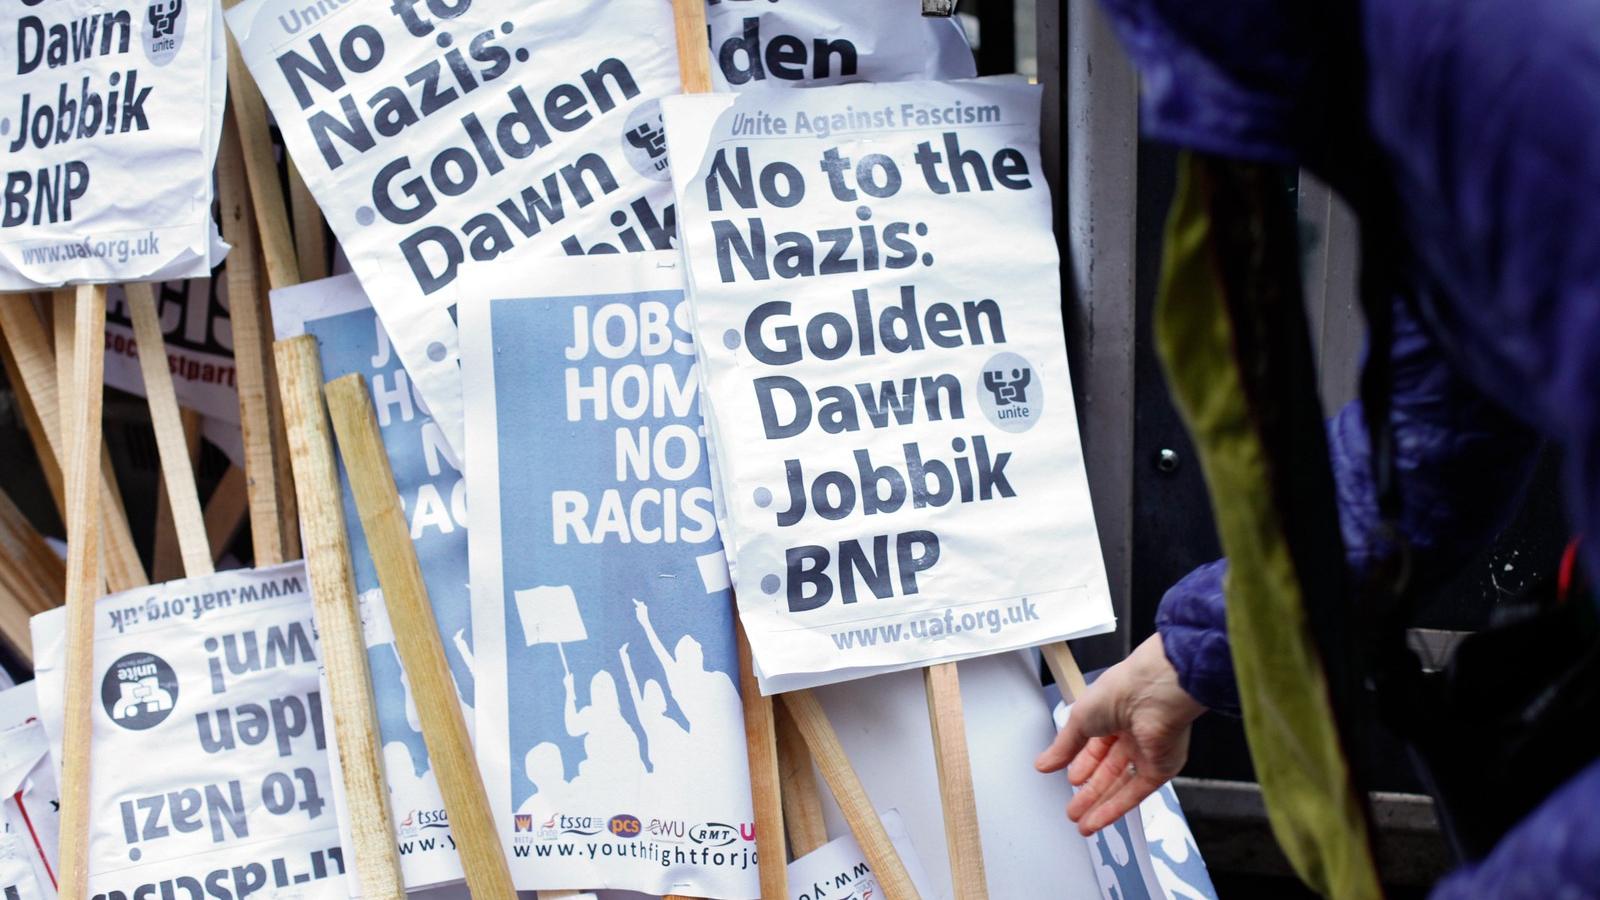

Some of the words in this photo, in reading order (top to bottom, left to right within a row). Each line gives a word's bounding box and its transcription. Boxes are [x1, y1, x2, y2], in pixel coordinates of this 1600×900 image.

[17, 8, 131, 76] Dawn
[276, 24, 385, 111] No
[10, 70, 154, 154] Jobbik
[308, 21, 530, 171] Nazis:
[731, 110, 788, 136] Unite
[794, 106, 896, 139] Against
[900, 100, 1001, 127] Fascism
[371, 57, 641, 225] Golden
[705, 146, 805, 211] No
[820, 147, 902, 202] to
[914, 132, 1032, 195] the
[1, 160, 90, 228] BNP
[399, 152, 619, 296] Dawn
[22, 231, 160, 265] www.uaf.org.uk
[711, 206, 934, 283] Nazis:
[565, 300, 695, 361] JOBS
[744, 285, 1007, 366] Golden
[753, 370, 965, 440] Dawn
[997, 405, 1030, 420] unite
[615, 424, 705, 482] NO
[776, 435, 1017, 527] Jobbik
[552, 487, 716, 546] RACIS
[109, 576, 303, 634] www.uaf.org.uk
[785, 530, 941, 613] BNP
[204, 617, 319, 694] wn!
[831, 597, 1040, 650] www.uaf.org.uk
[117, 663, 158, 681] unite
[120, 780, 250, 862] Nazi
[261, 767, 325, 820] to
[560, 814, 592, 829] tssa
[612, 818, 642, 835] pcs
[699, 830, 730, 840] RMT
